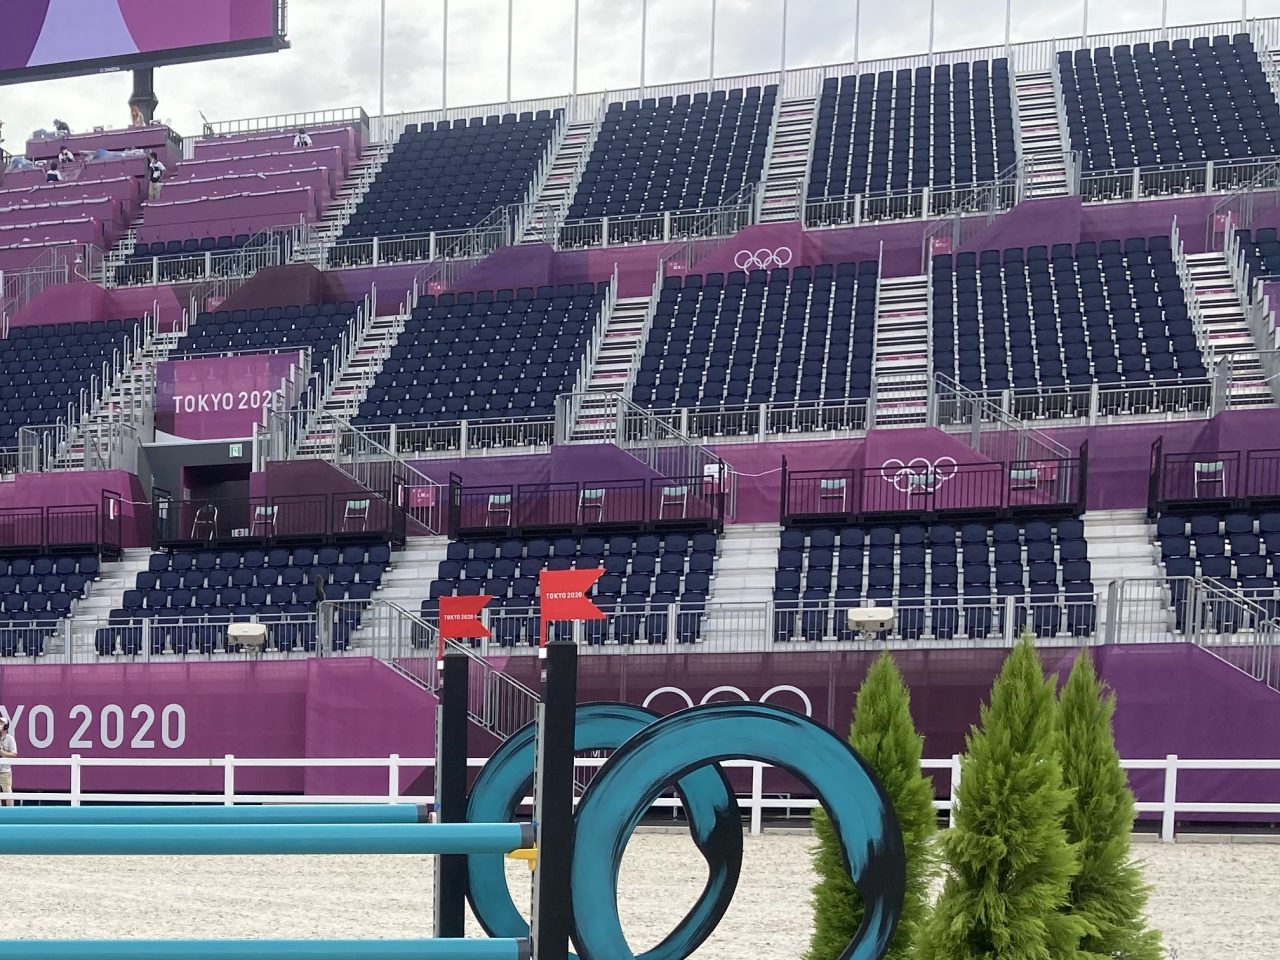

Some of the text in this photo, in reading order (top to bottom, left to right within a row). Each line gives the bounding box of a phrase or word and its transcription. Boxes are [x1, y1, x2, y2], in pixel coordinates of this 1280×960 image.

[172, 392, 233, 414] TOKYO
[545, 591, 583, 600] TOKYO 2020
[69, 704, 186, 749] 2020
